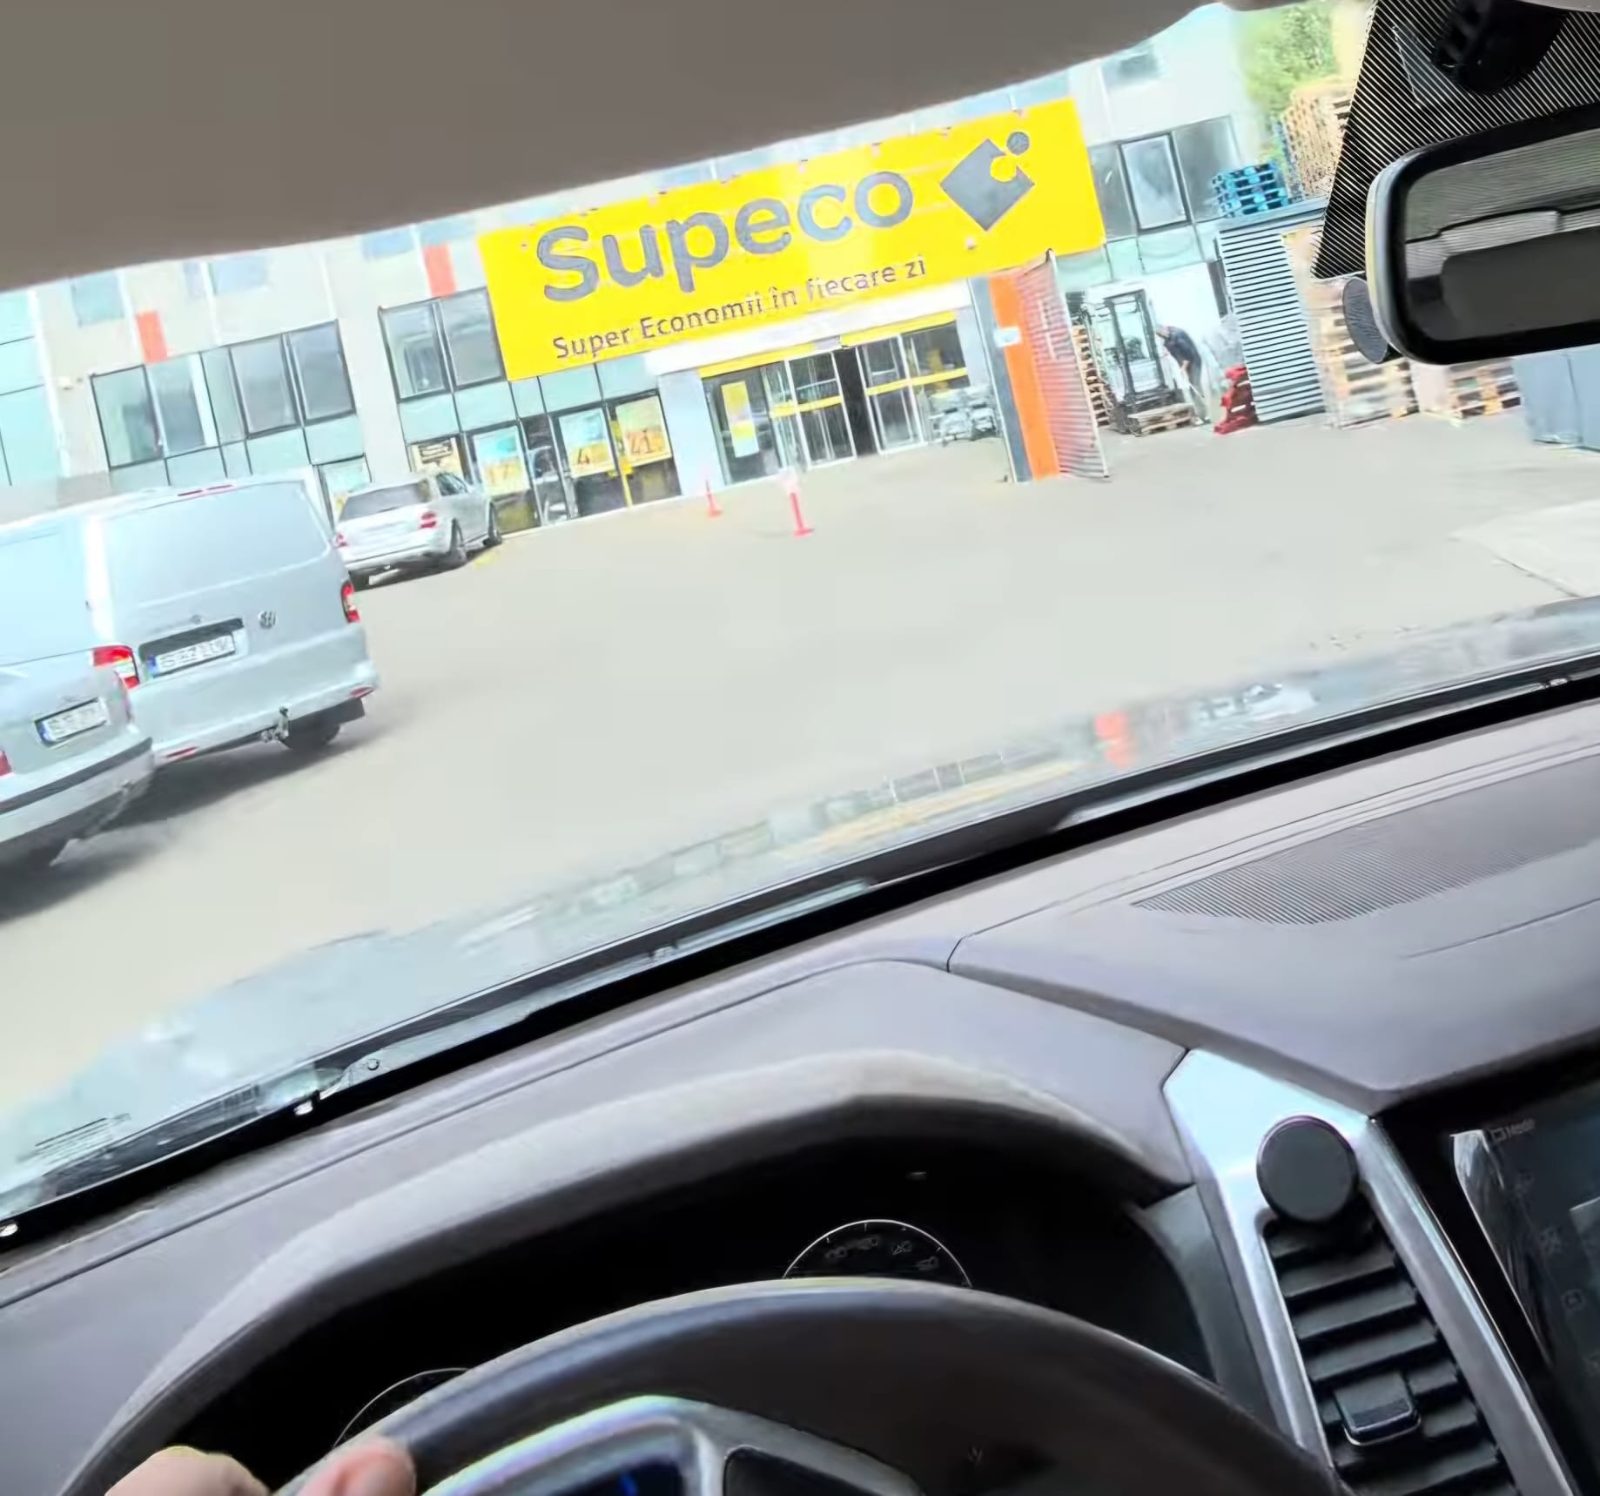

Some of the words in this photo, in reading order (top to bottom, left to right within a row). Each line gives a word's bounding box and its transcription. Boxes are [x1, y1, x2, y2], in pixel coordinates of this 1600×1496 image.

[537, 172, 913, 301] Supeco
[552, 328, 631, 358] Super
[640, 291, 763, 340] Economii
[769, 286, 797, 309] în
[806, 266, 897, 302] fiecare
[904, 254, 926, 279] zi
